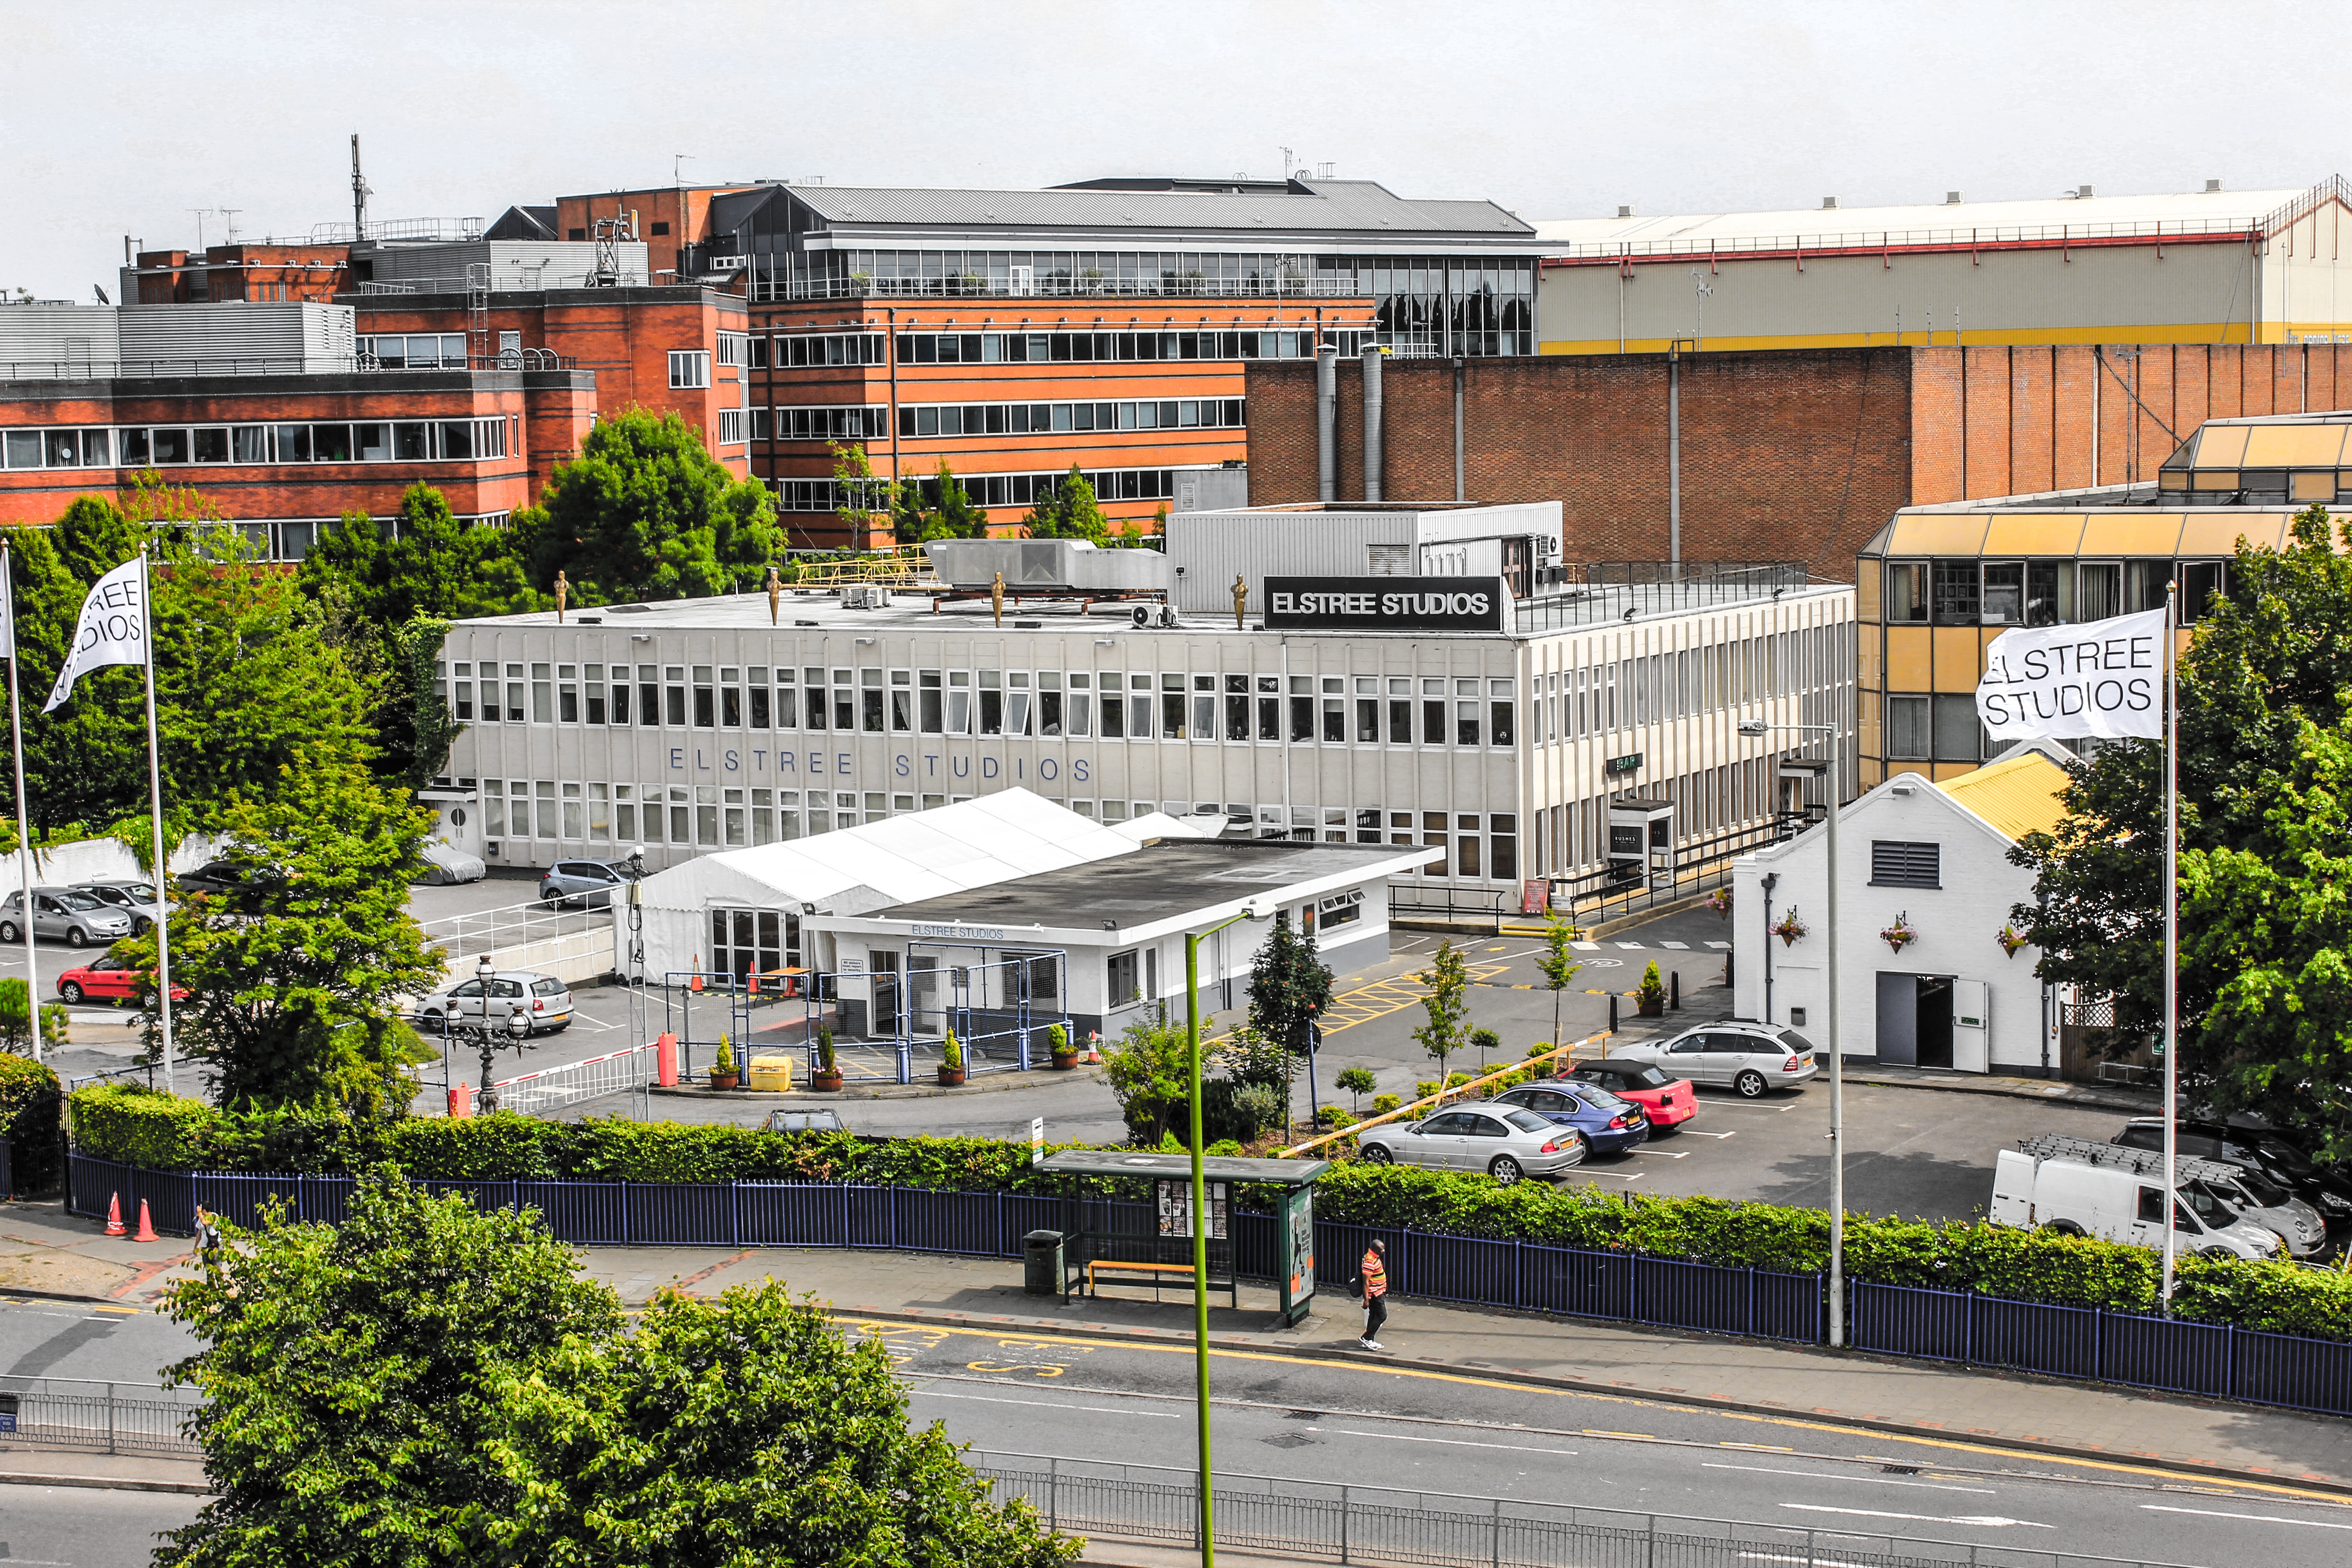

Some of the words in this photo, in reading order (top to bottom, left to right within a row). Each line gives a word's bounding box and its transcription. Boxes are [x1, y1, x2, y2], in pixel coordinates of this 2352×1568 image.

[1272, 592, 1377, 615] ELSTREE
[1382, 593, 1490, 615] STUDIOS
[1985, 678, 2151, 725] STUDIOS
[670, 748, 851, 774] ELSTREE
[895, 754, 1089, 782] STUDIOS
[1619, 756, 1635, 770] BAR
[912, 925, 956, 937] ELSTREE
[959, 927, 1004, 940] STUDIOS
